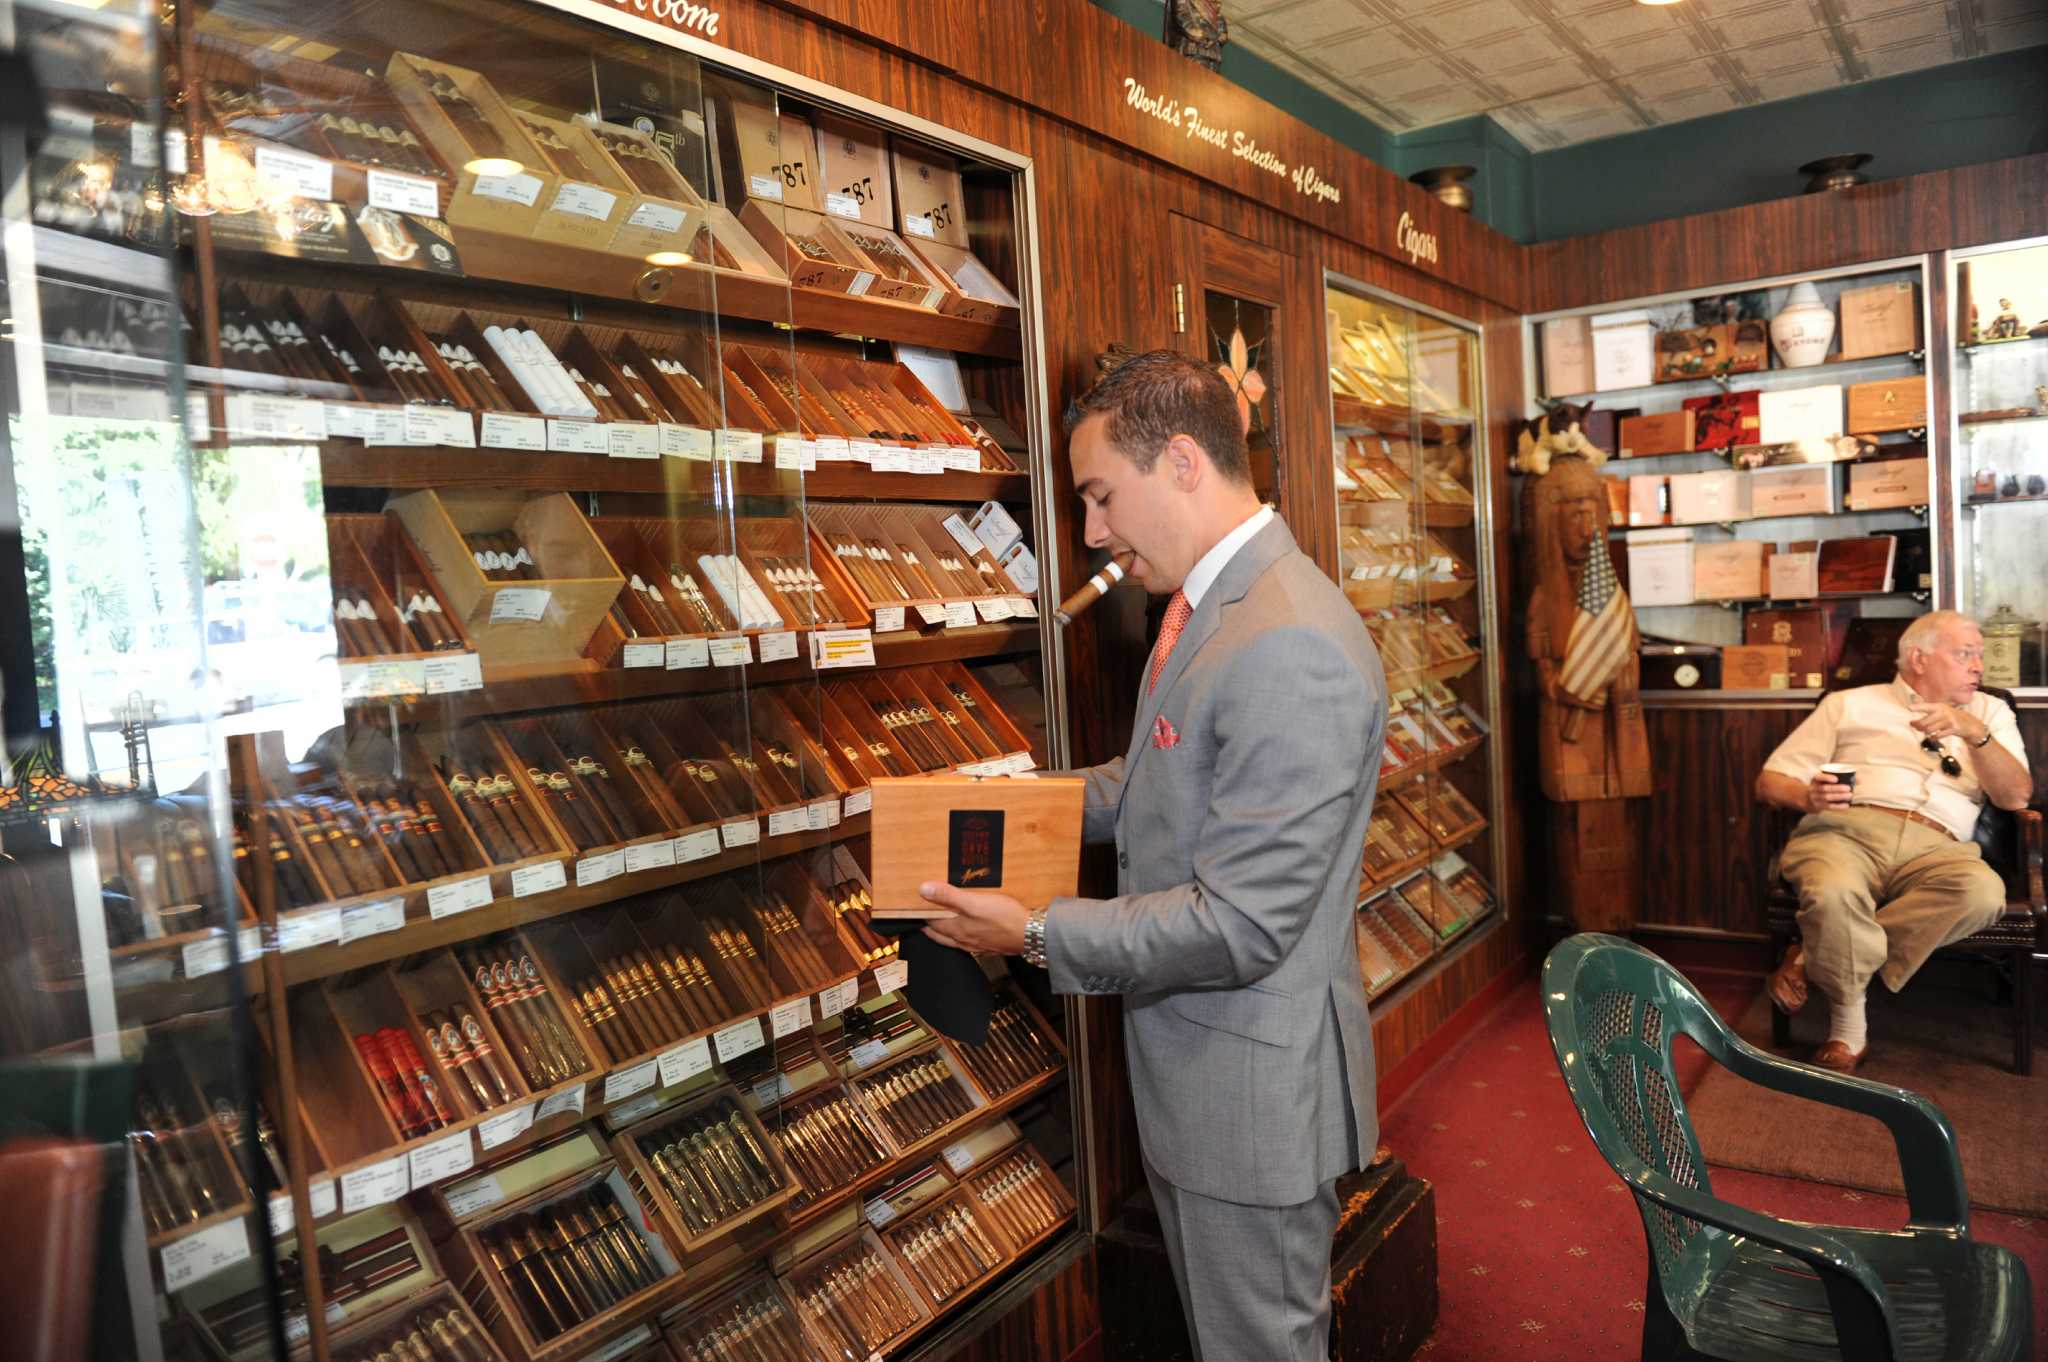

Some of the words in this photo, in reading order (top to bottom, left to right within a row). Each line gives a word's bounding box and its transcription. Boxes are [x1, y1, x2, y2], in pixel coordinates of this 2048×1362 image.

[613, 0, 719, 36] oom
[1125, 77, 1180, 127] World's
[1184, 107, 1228, 149] Finest
[1232, 131, 1286, 177] Selection
[1292, 165, 1304, 193] of
[1304, 166, 1340, 203] Cigars
[1397, 211, 1437, 264] Cigars
